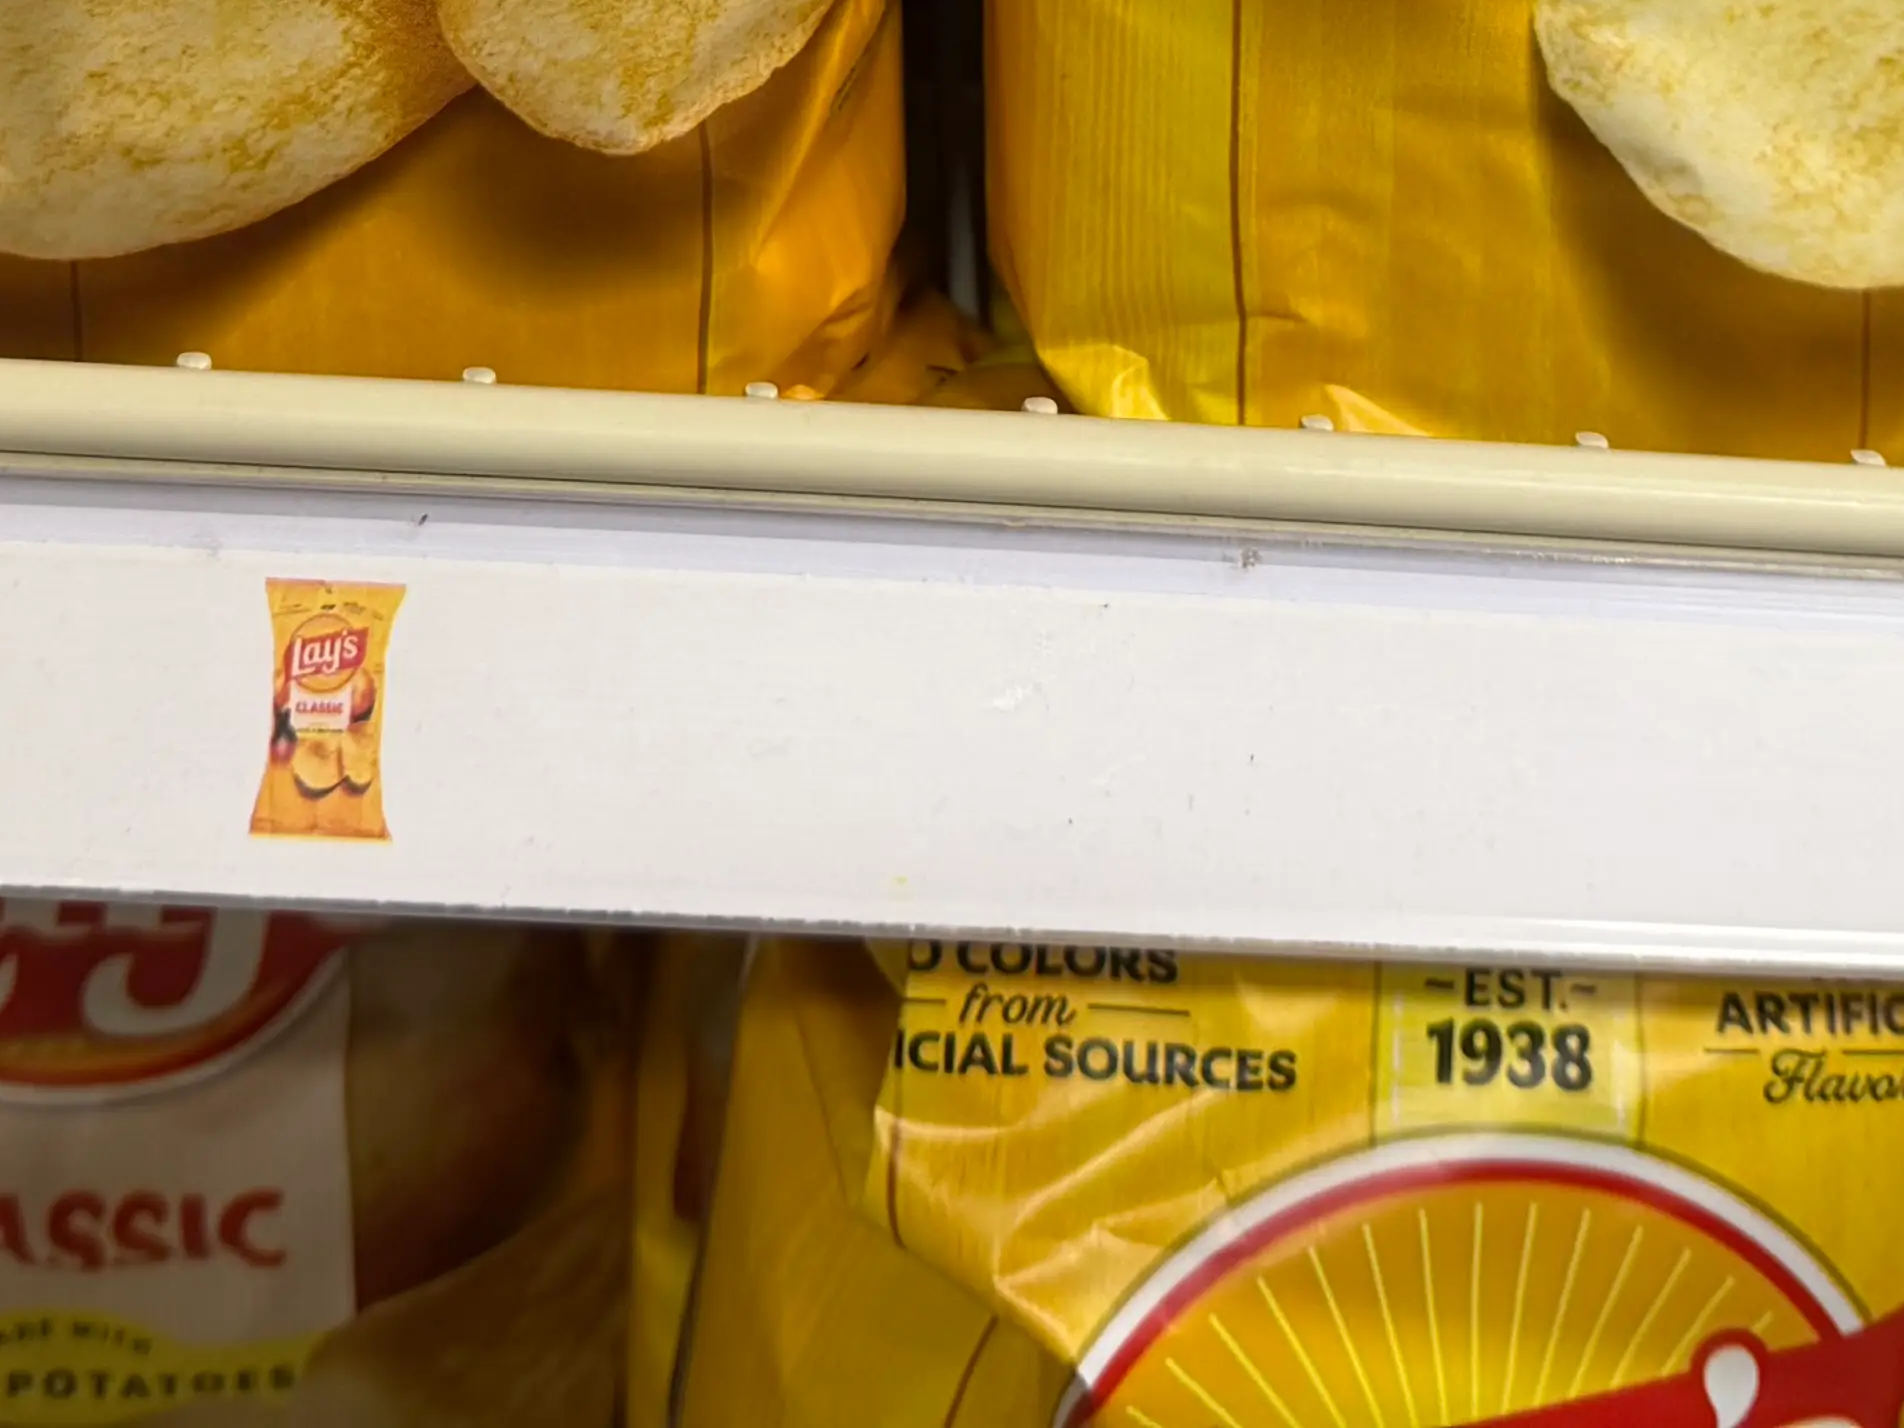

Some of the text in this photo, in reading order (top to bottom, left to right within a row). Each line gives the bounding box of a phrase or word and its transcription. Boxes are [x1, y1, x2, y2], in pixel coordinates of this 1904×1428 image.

[290, 629, 360, 677] Lay's
[958, 982, 1078, 1027] from
[1043, 1035, 1299, 1092] SOURCES
[1425, 1016, 1594, 1093] 1938
